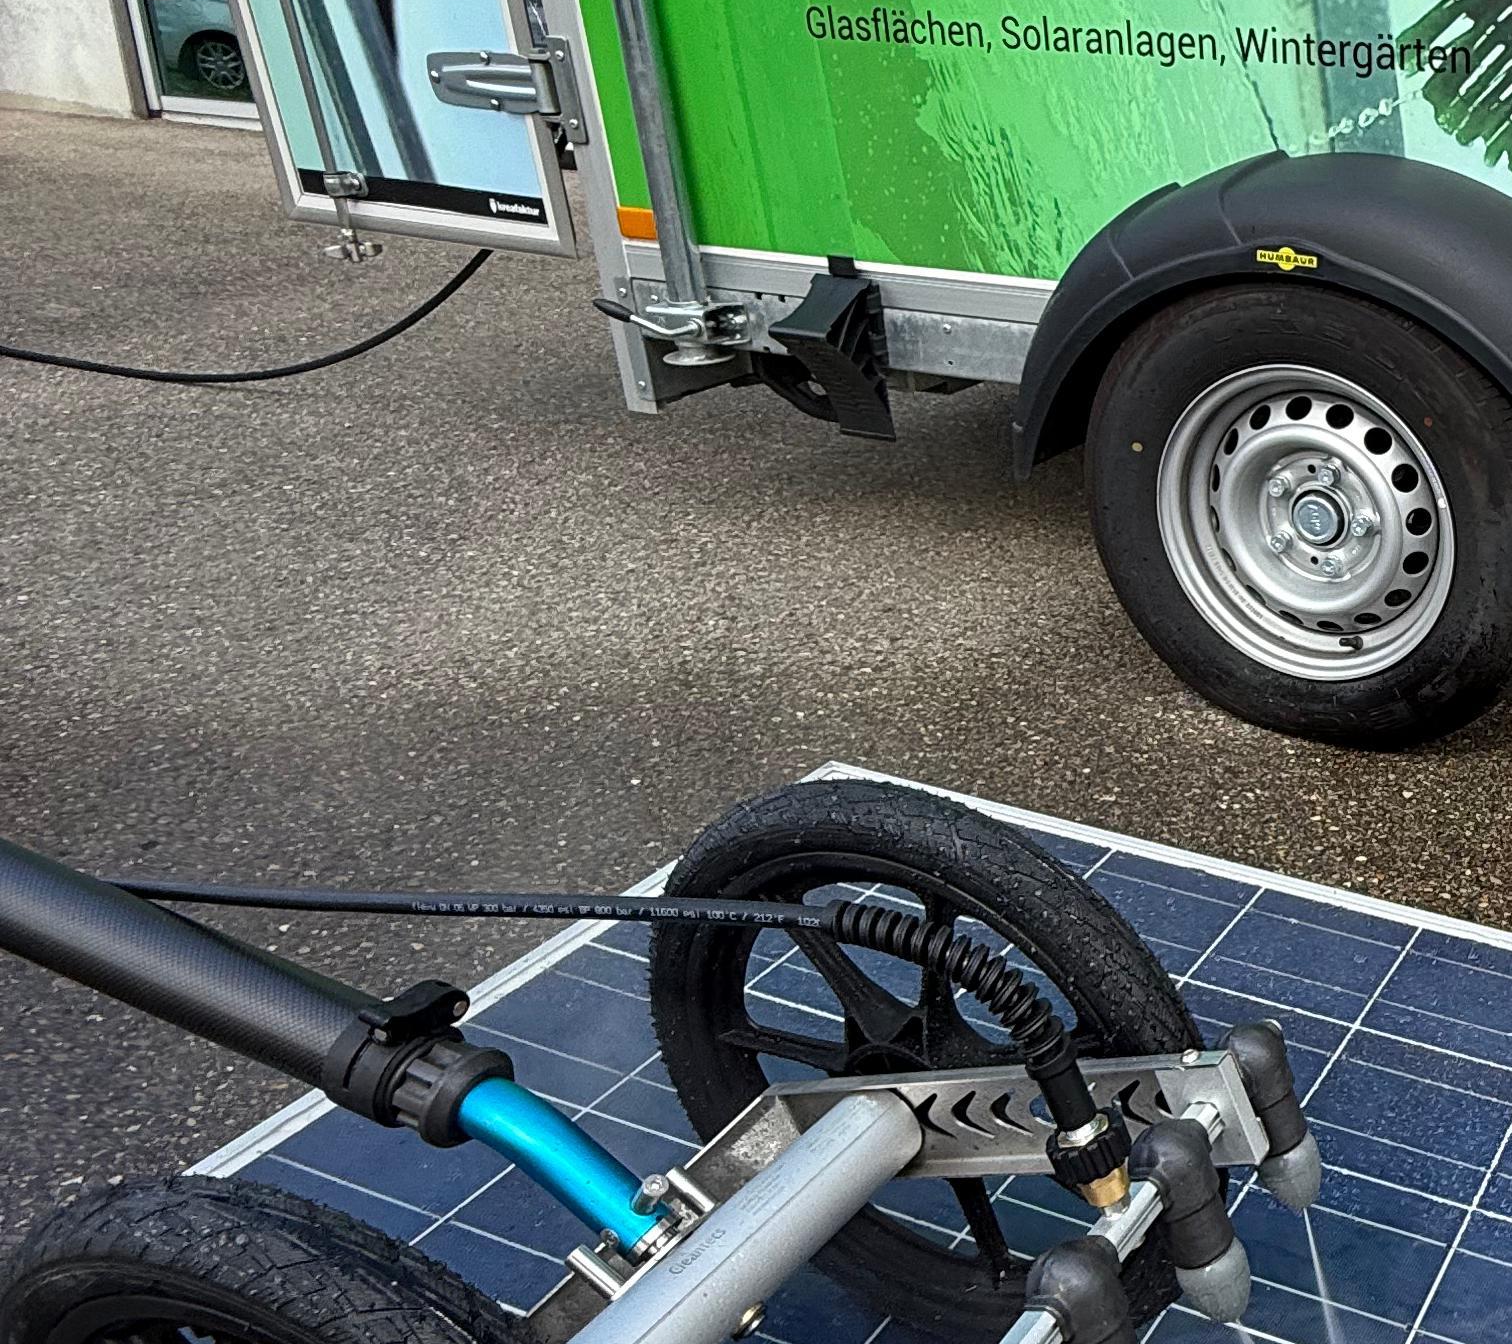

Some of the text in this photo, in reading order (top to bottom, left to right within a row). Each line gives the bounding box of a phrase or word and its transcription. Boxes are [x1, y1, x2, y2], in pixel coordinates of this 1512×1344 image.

[804, 4, 1474, 80] Glasflächen, Solaranlagen, Wintergärten
[1259, 251, 1315, 266] HUMBAUR
[616, 905, 633, 916] bar
[683, 909, 700, 919] psi
[753, 912, 785, 924] 212°F
